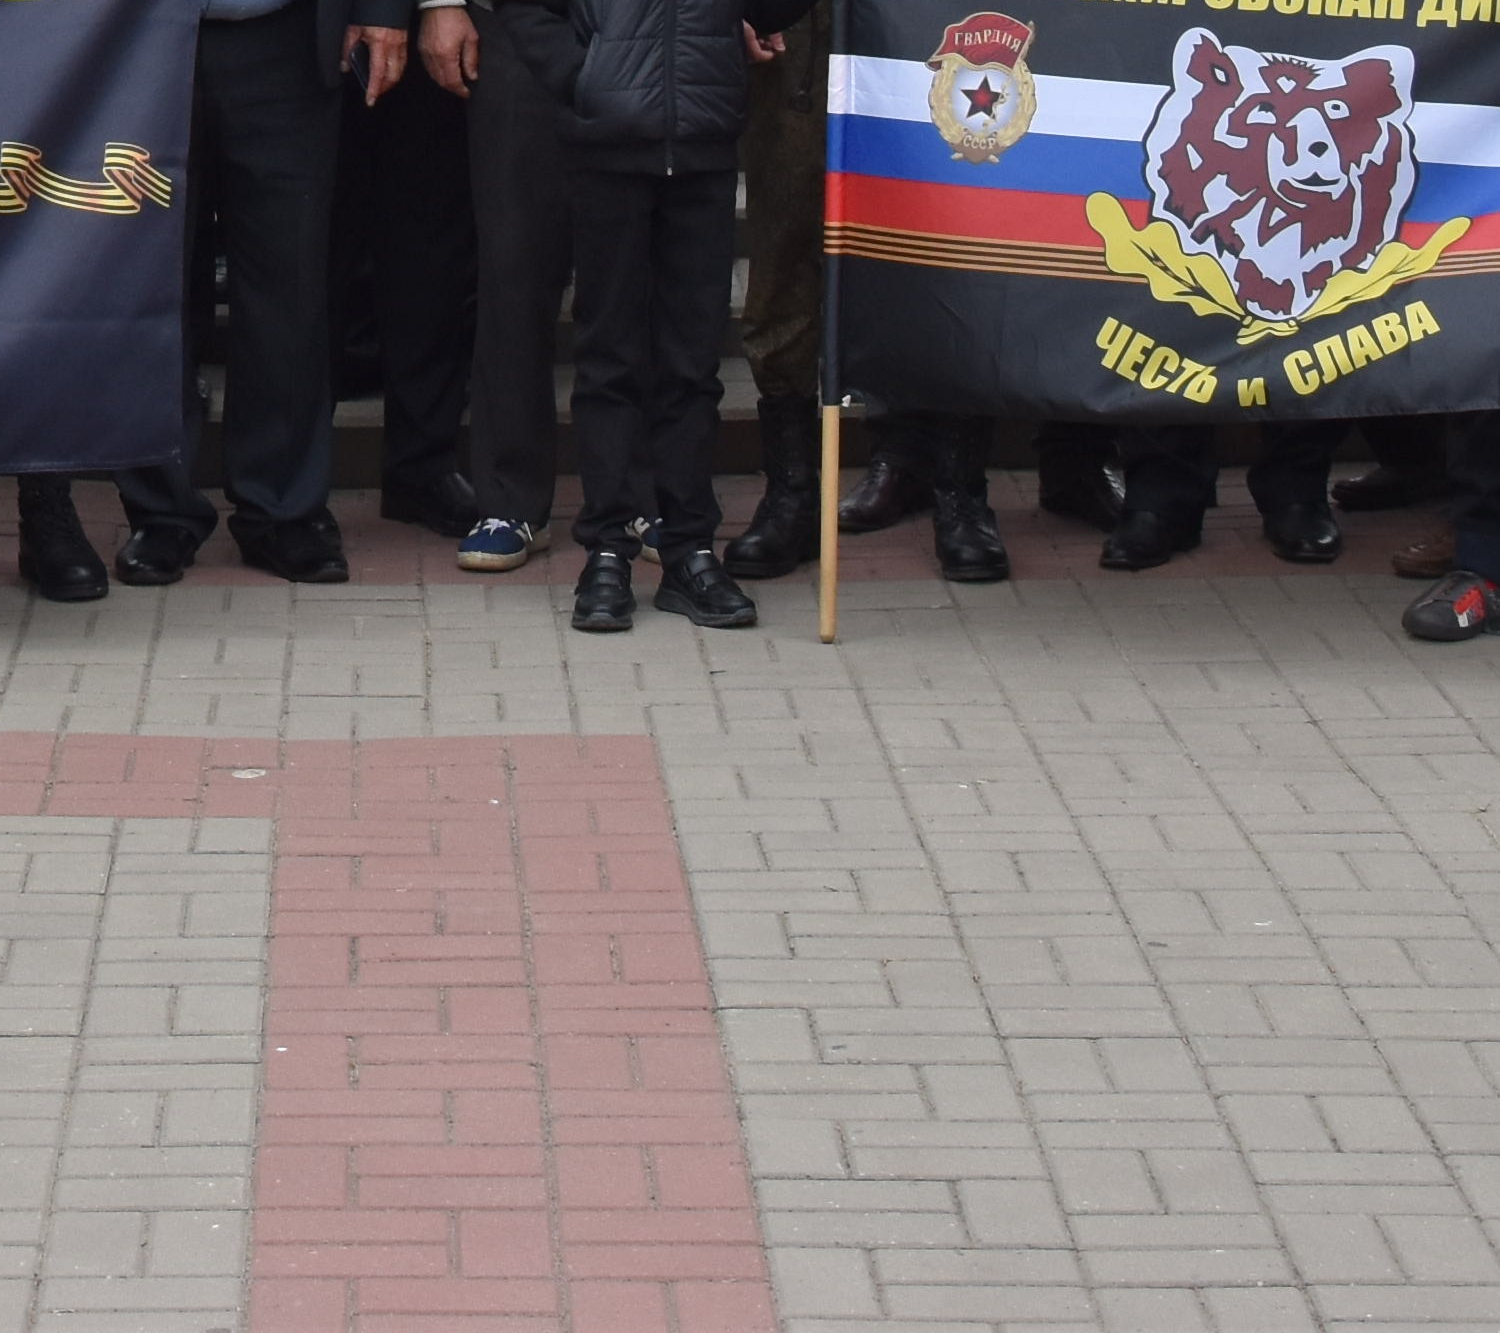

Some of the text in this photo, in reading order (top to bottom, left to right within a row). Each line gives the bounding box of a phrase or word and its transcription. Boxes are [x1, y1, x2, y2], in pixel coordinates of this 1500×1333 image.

[954, 29, 1022, 53] ГВАРДИЯ
[963, 135, 997, 150] СССР
[1095, 315, 1219, 405] ЧЕСТЬ
[1283, 300, 1441, 395] СЛАВА
